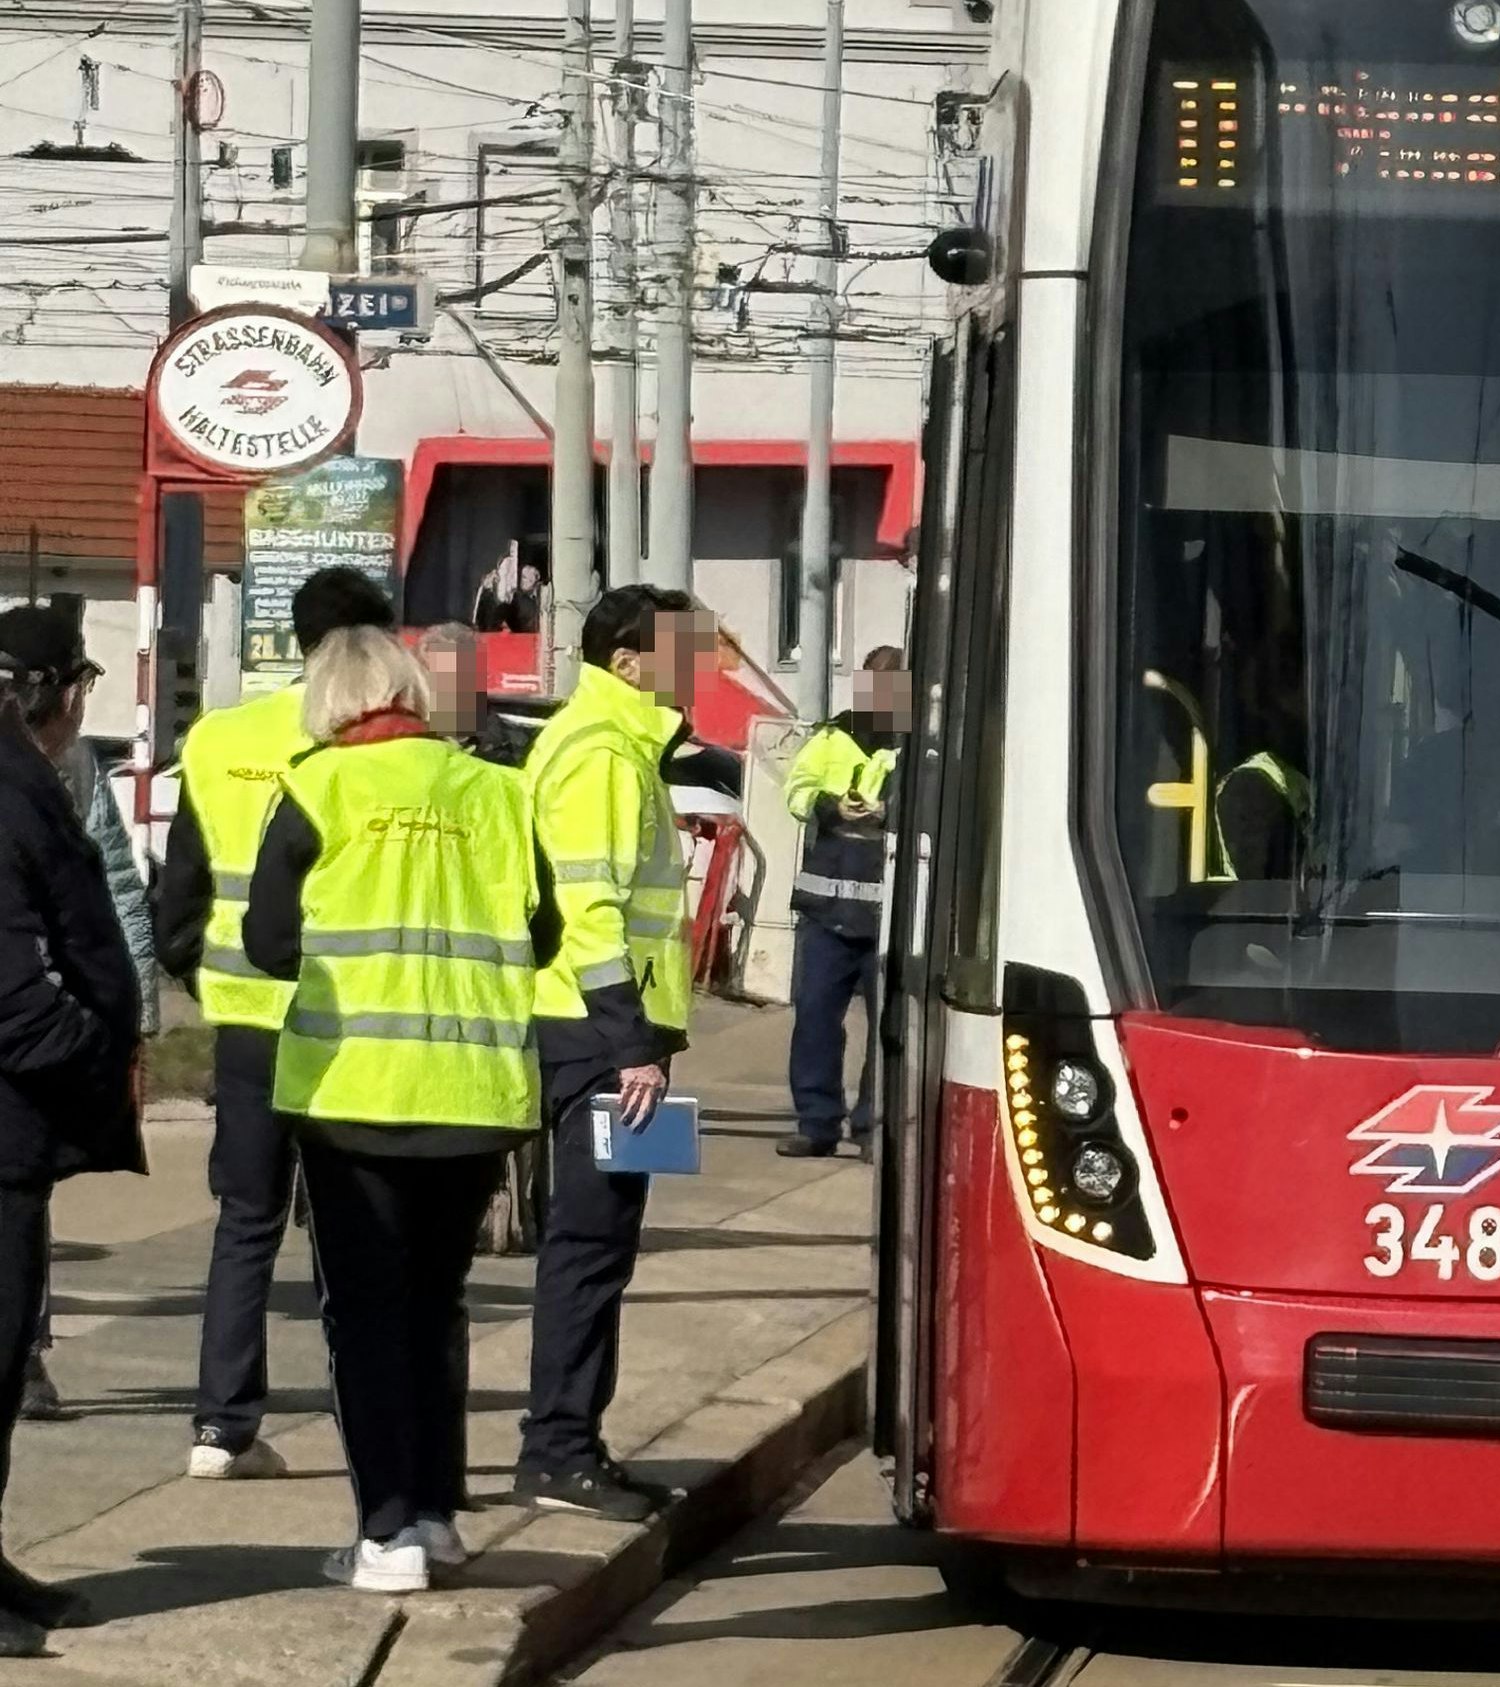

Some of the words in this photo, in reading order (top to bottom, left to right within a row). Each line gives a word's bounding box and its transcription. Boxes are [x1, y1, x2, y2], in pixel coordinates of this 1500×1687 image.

[331, 293, 388, 316] ZEI
[174, 325, 340, 387] STRASSENBAHN
[179, 404, 330, 458] HALTESTELLE
